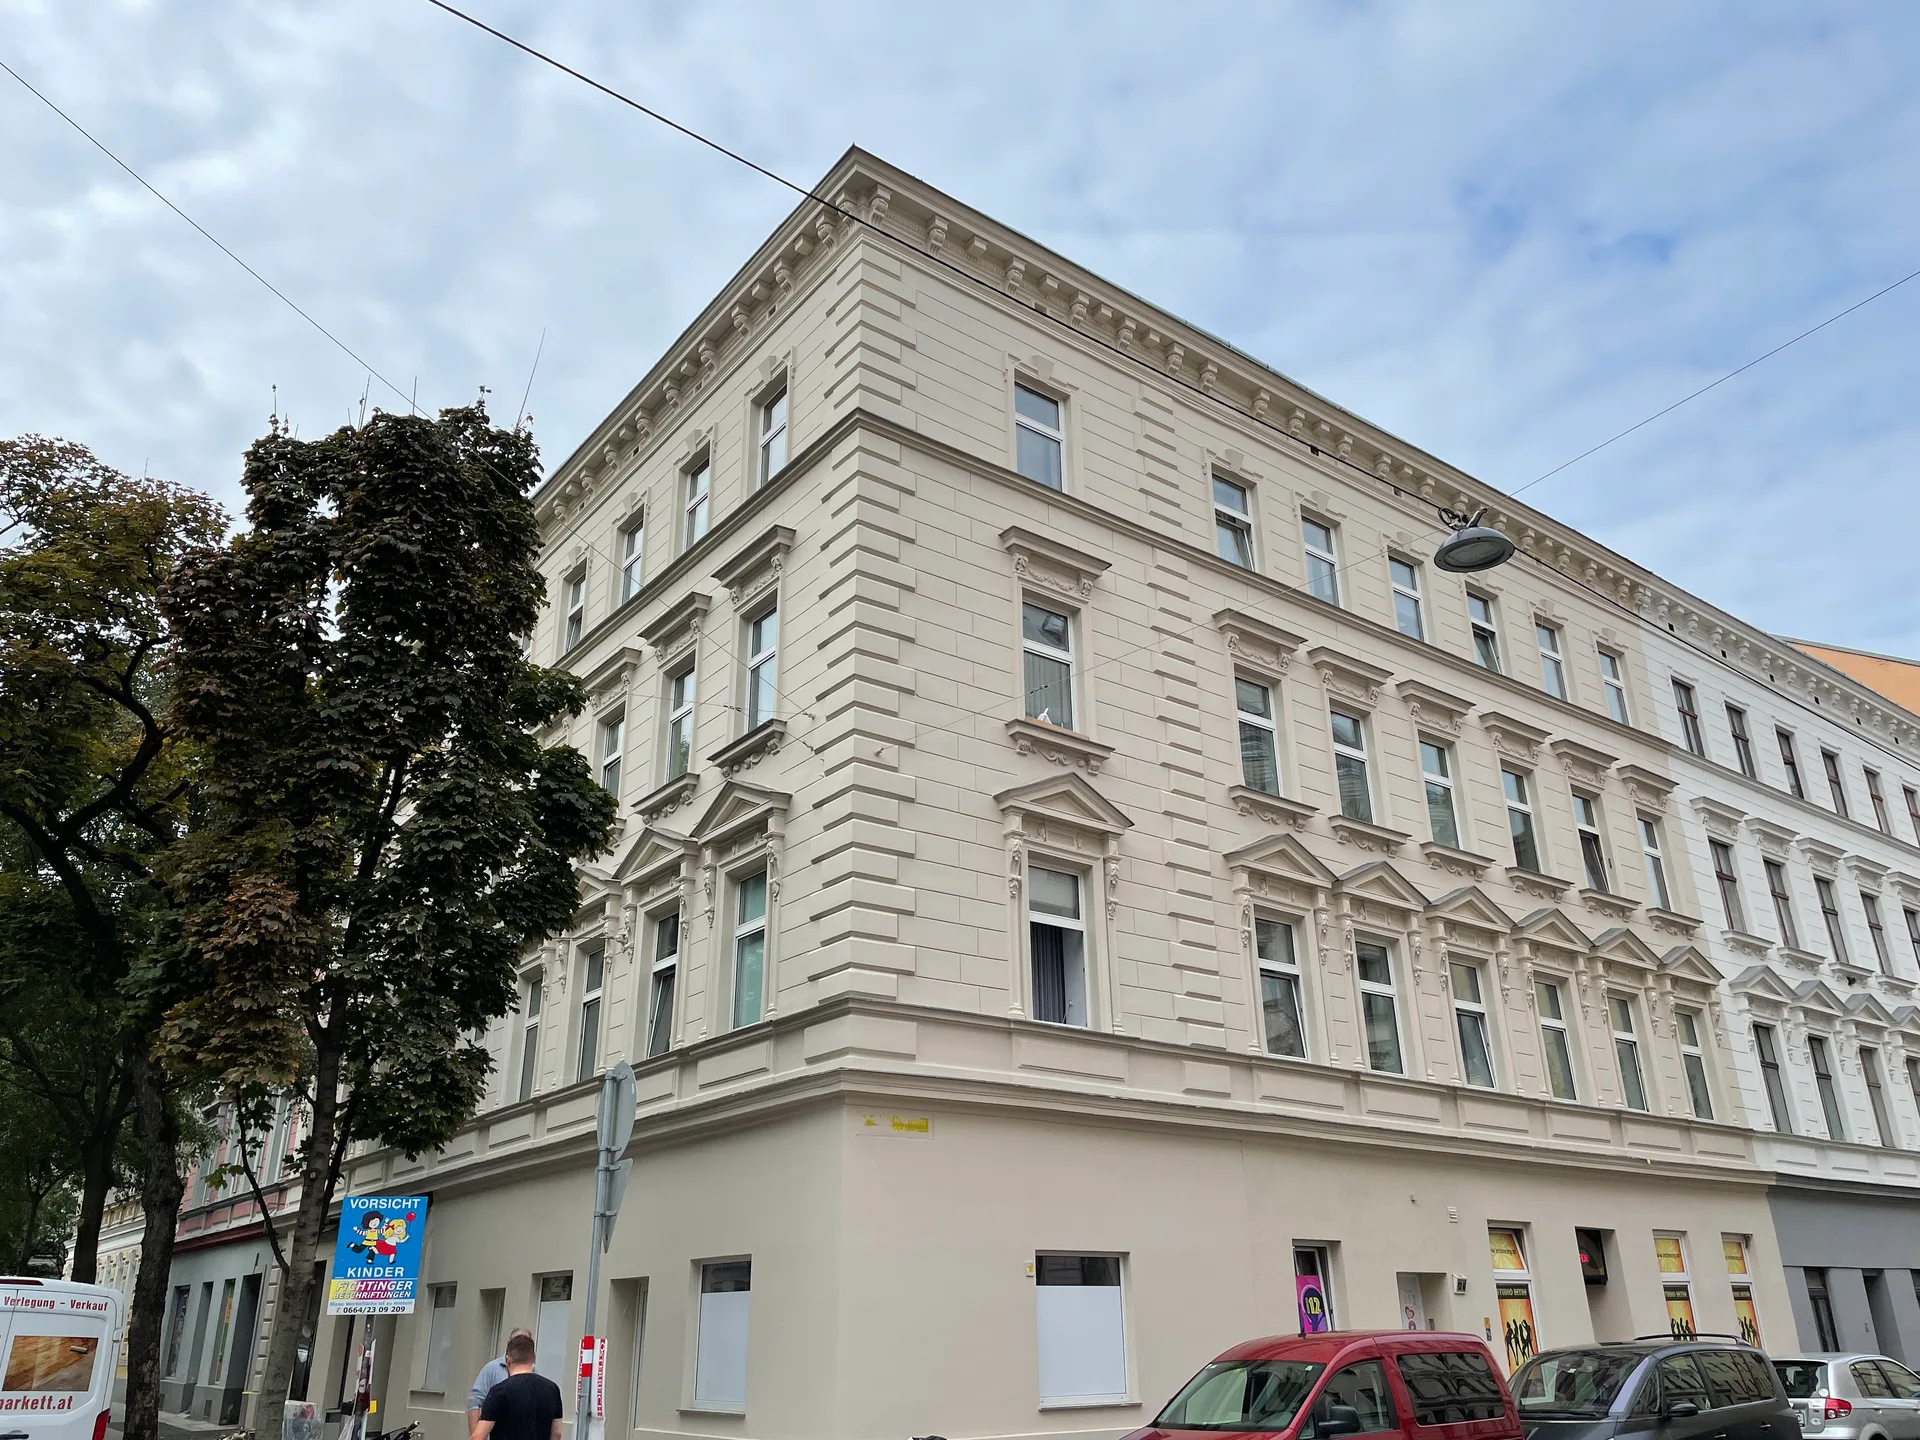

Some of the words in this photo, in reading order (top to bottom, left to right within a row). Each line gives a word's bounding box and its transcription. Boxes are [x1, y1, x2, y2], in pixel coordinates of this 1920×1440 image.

[350, 1198, 420, 1209] VORSICHT
[347, 1267, 404, 1278] KINDER
[3, 1296, 55, 1310] Verlegung
[70, 1299, 108, 1311] Verkauf
[343, 1306, 376, 1314] 0664/23
[391, 1305, 406, 1313] 209
